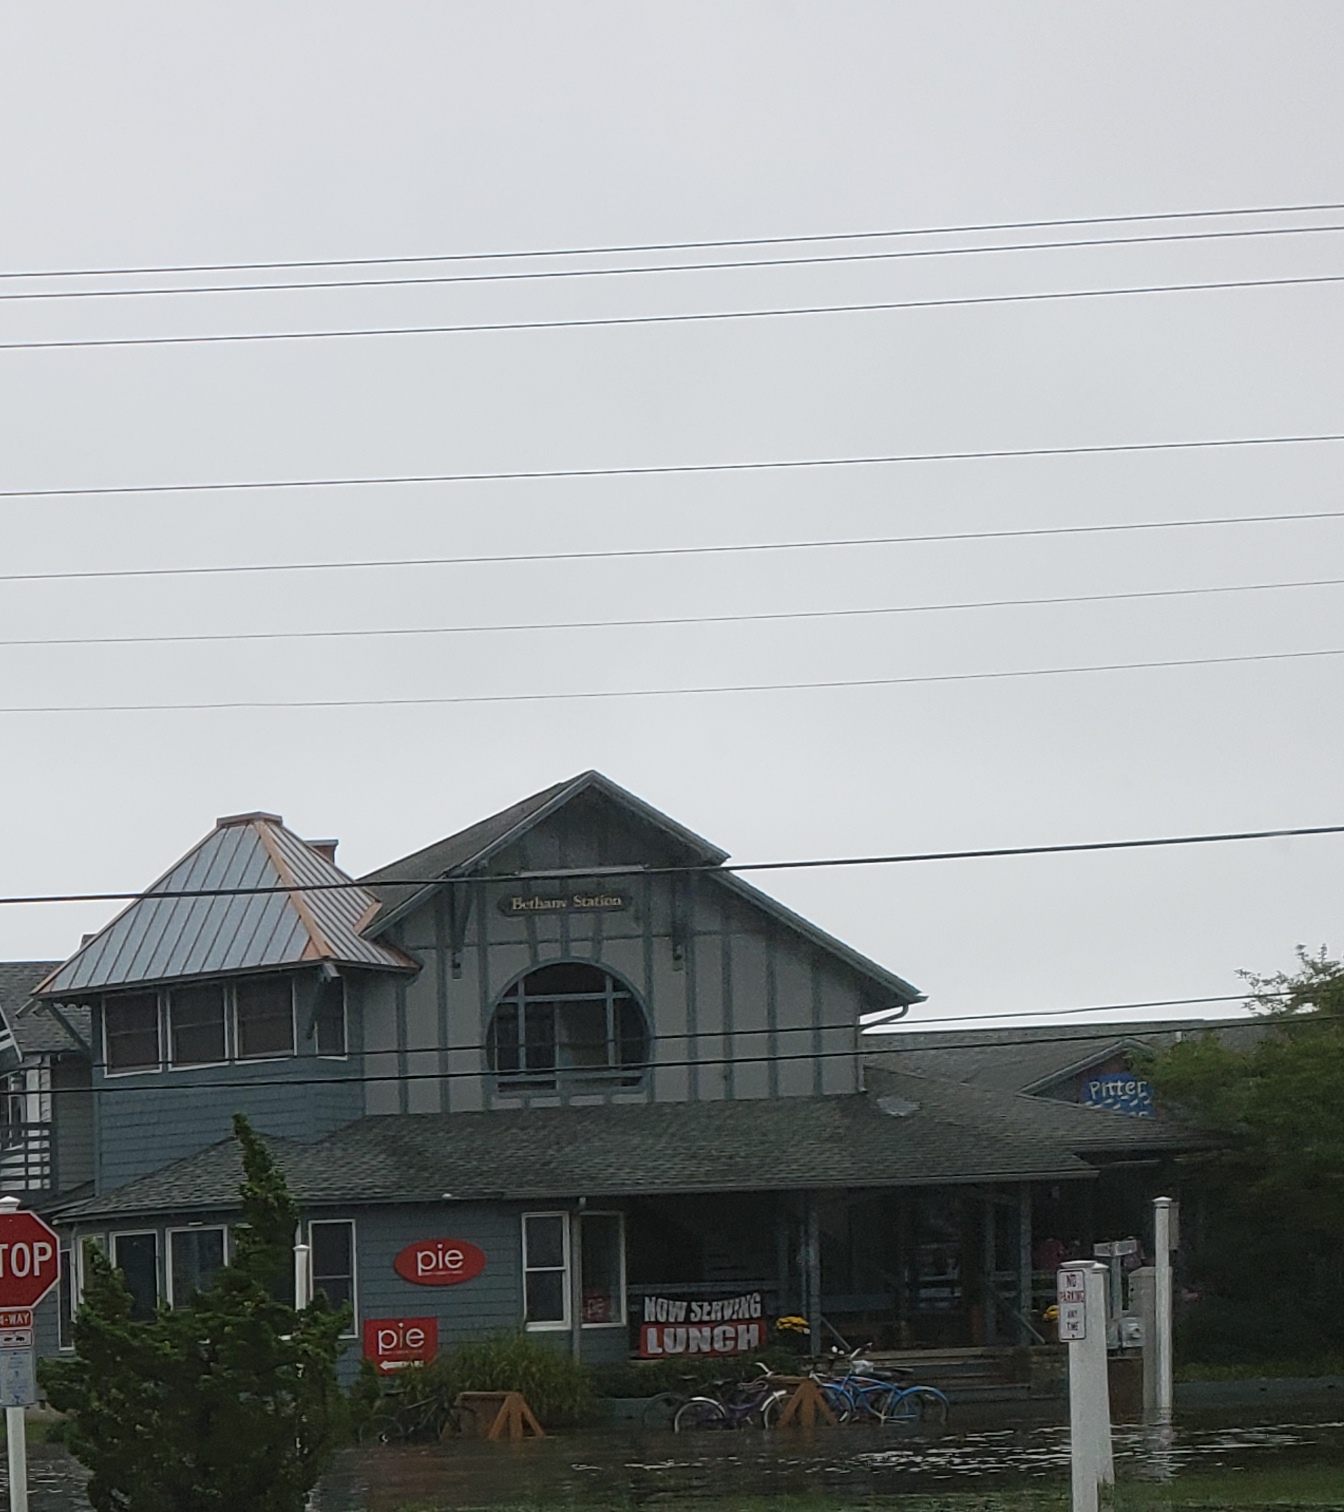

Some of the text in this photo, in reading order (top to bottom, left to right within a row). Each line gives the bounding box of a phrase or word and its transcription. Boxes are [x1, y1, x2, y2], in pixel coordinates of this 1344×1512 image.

[573, 894, 622, 907] Station
[417, 1243, 464, 1276] pie
[1066, 1274, 1076, 1288] NO
[644, 1292, 761, 1322] NOW SERVING
[377, 1322, 425, 1356] pie
[647, 1324, 759, 1354] LUNCH
